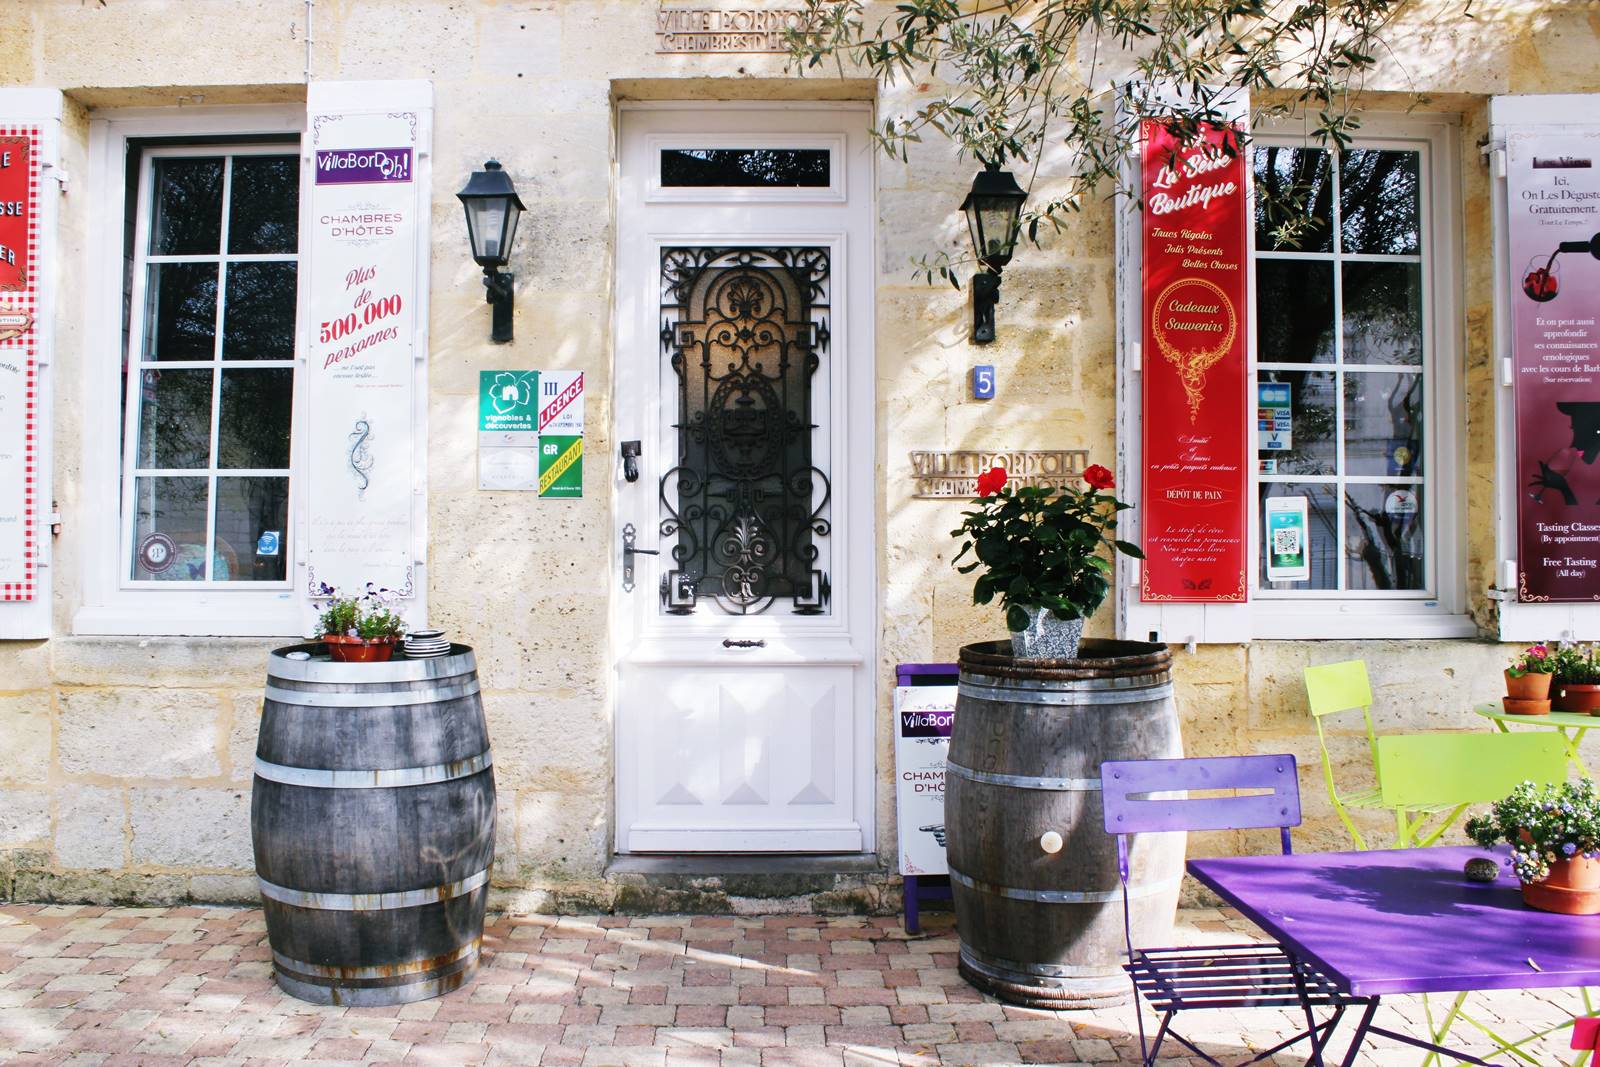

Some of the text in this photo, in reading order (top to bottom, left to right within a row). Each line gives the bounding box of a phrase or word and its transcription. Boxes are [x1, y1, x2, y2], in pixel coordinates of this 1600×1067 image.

[1149, 182, 1238, 215] Boutique
[1522, 190, 1538, 200] On
[1541, 189, 1559, 200] Les
[320, 213, 403, 225] CHAMBRES
[331, 225, 394, 237] D'HÔTES
[1151, 227, 1213, 240] Trucs Rigolos
[1164, 243, 1184, 254] Jolis
[1182, 258, 1238, 270] Belles Choses
[345, 264, 376, 291] Plus
[354, 288, 371, 309] de
[1168, 300, 1220, 314] Cadeaux
[320, 294, 402, 344] 500.000
[1164, 317, 1223, 332] Souvenirs
[323, 326, 399, 370] personnes
[1539, 365, 1549, 373] les
[1572, 365, 1582, 373] de
[980, 371, 991, 393] 5
[544, 382, 558, 395] III
[540, 378, 582, 427] LICENCE
[485, 414, 524, 423] vignobles
[543, 444, 558, 455] GR
[540, 439, 582, 492] RESTAURANT
[1166, 488, 1222, 500] DÉPÔT DE PAIN
[1536, 522, 1570, 534] Tasting
[1543, 556, 1597, 568] Free Tasting
[1556, 569, 1586, 578] (All day)
[903, 712, 954, 728] VillaBor
[903, 771, 944, 781] CHAM
[914, 781, 945, 792] D'HÔ
